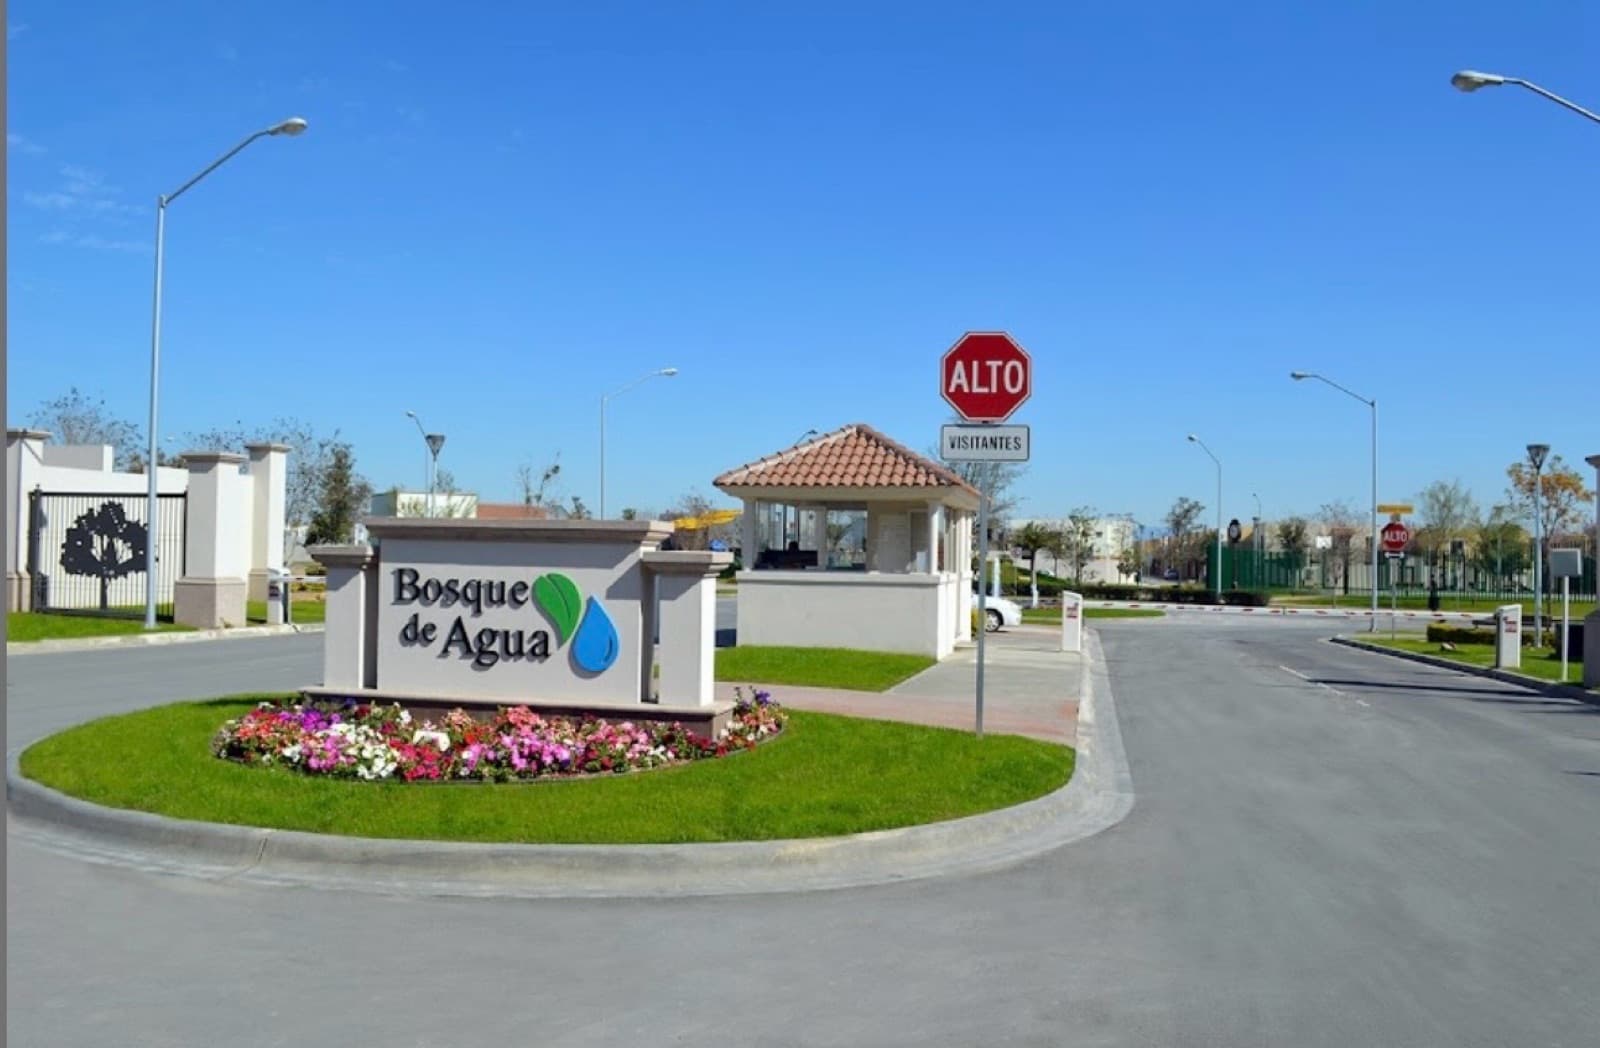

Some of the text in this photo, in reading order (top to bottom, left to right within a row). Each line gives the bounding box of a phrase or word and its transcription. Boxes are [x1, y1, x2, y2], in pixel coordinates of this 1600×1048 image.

[948, 360, 1024, 394] ALTO
[948, 435, 1022, 451] VISITANTES
[1383, 530, 1408, 542] ALTO
[391, 567, 529, 616] Bosque
[400, 613, 550, 669] de Agua
